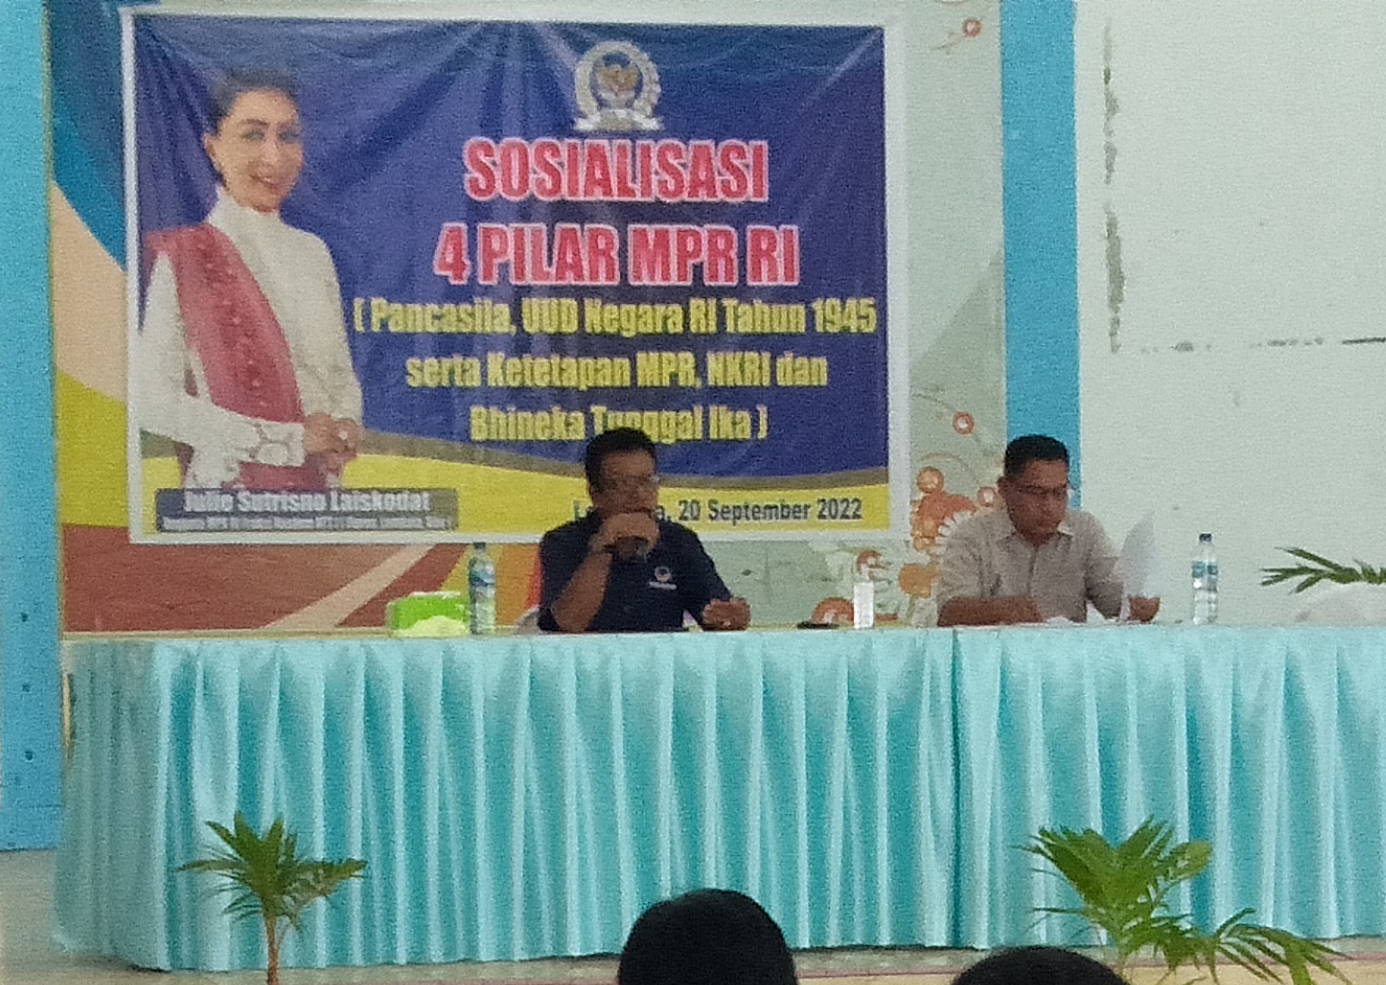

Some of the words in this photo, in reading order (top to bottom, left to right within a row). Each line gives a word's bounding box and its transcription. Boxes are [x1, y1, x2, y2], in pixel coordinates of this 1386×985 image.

[464, 137, 769, 202] SOSIALISASI
[433, 222, 472, 286] 4
[477, 222, 620, 286] PILAR
[628, 224, 739, 286] MPR
[746, 224, 801, 286] RI
[370, 297, 517, 336] Pancasila,
[522, 298, 579, 335] UUD
[584, 297, 684, 339] Negara
[689, 297, 718, 334] RI
[722, 297, 807, 334] Tahun
[811, 297, 878, 334] 1945
[406, 355, 483, 388] serta
[487, 352, 632, 392] Ketetapan
[636, 351, 702, 389] MPR,
[707, 351, 772, 388] NKRI
[776, 351, 829, 388] dan
[470, 405, 587, 441] Bhineka
[590, 404, 704, 444] Tunggal
[709, 404, 752, 440] Ika
[679, 500, 701, 521] 20
[707, 499, 812, 525] September
[817, 498, 863, 521] 2022
